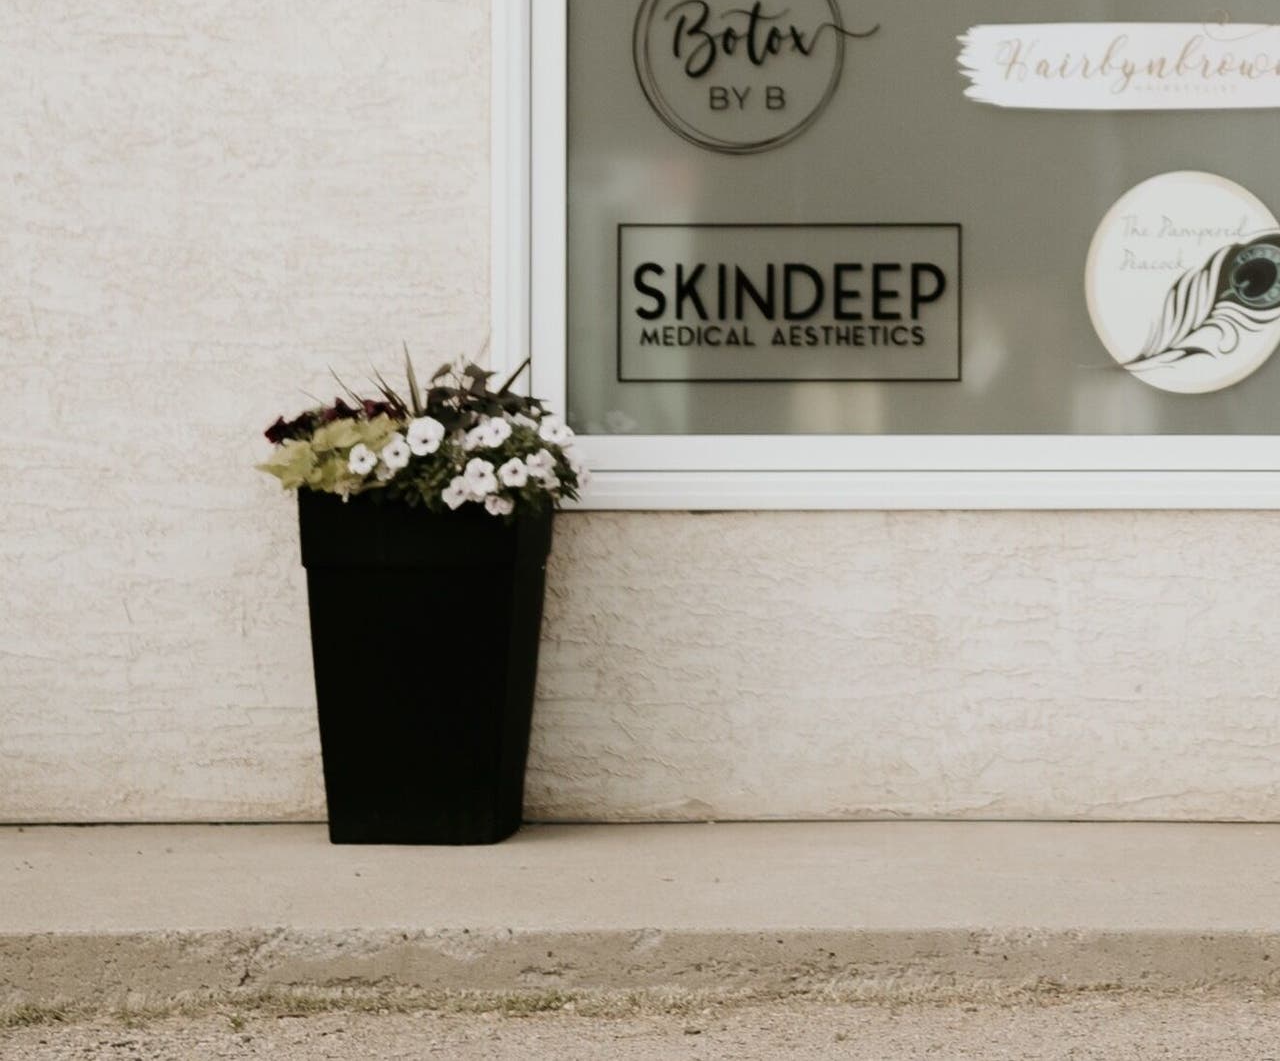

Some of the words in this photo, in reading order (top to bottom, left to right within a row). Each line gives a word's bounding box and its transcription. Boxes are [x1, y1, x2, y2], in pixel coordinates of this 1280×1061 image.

[709, 86, 752, 111] BY
[765, 86, 787, 111] B
[633, 261, 947, 322] SKINDEEP
[639, 325, 756, 347] MEDICAL
[771, 325, 927, 347] AESTHETICS
